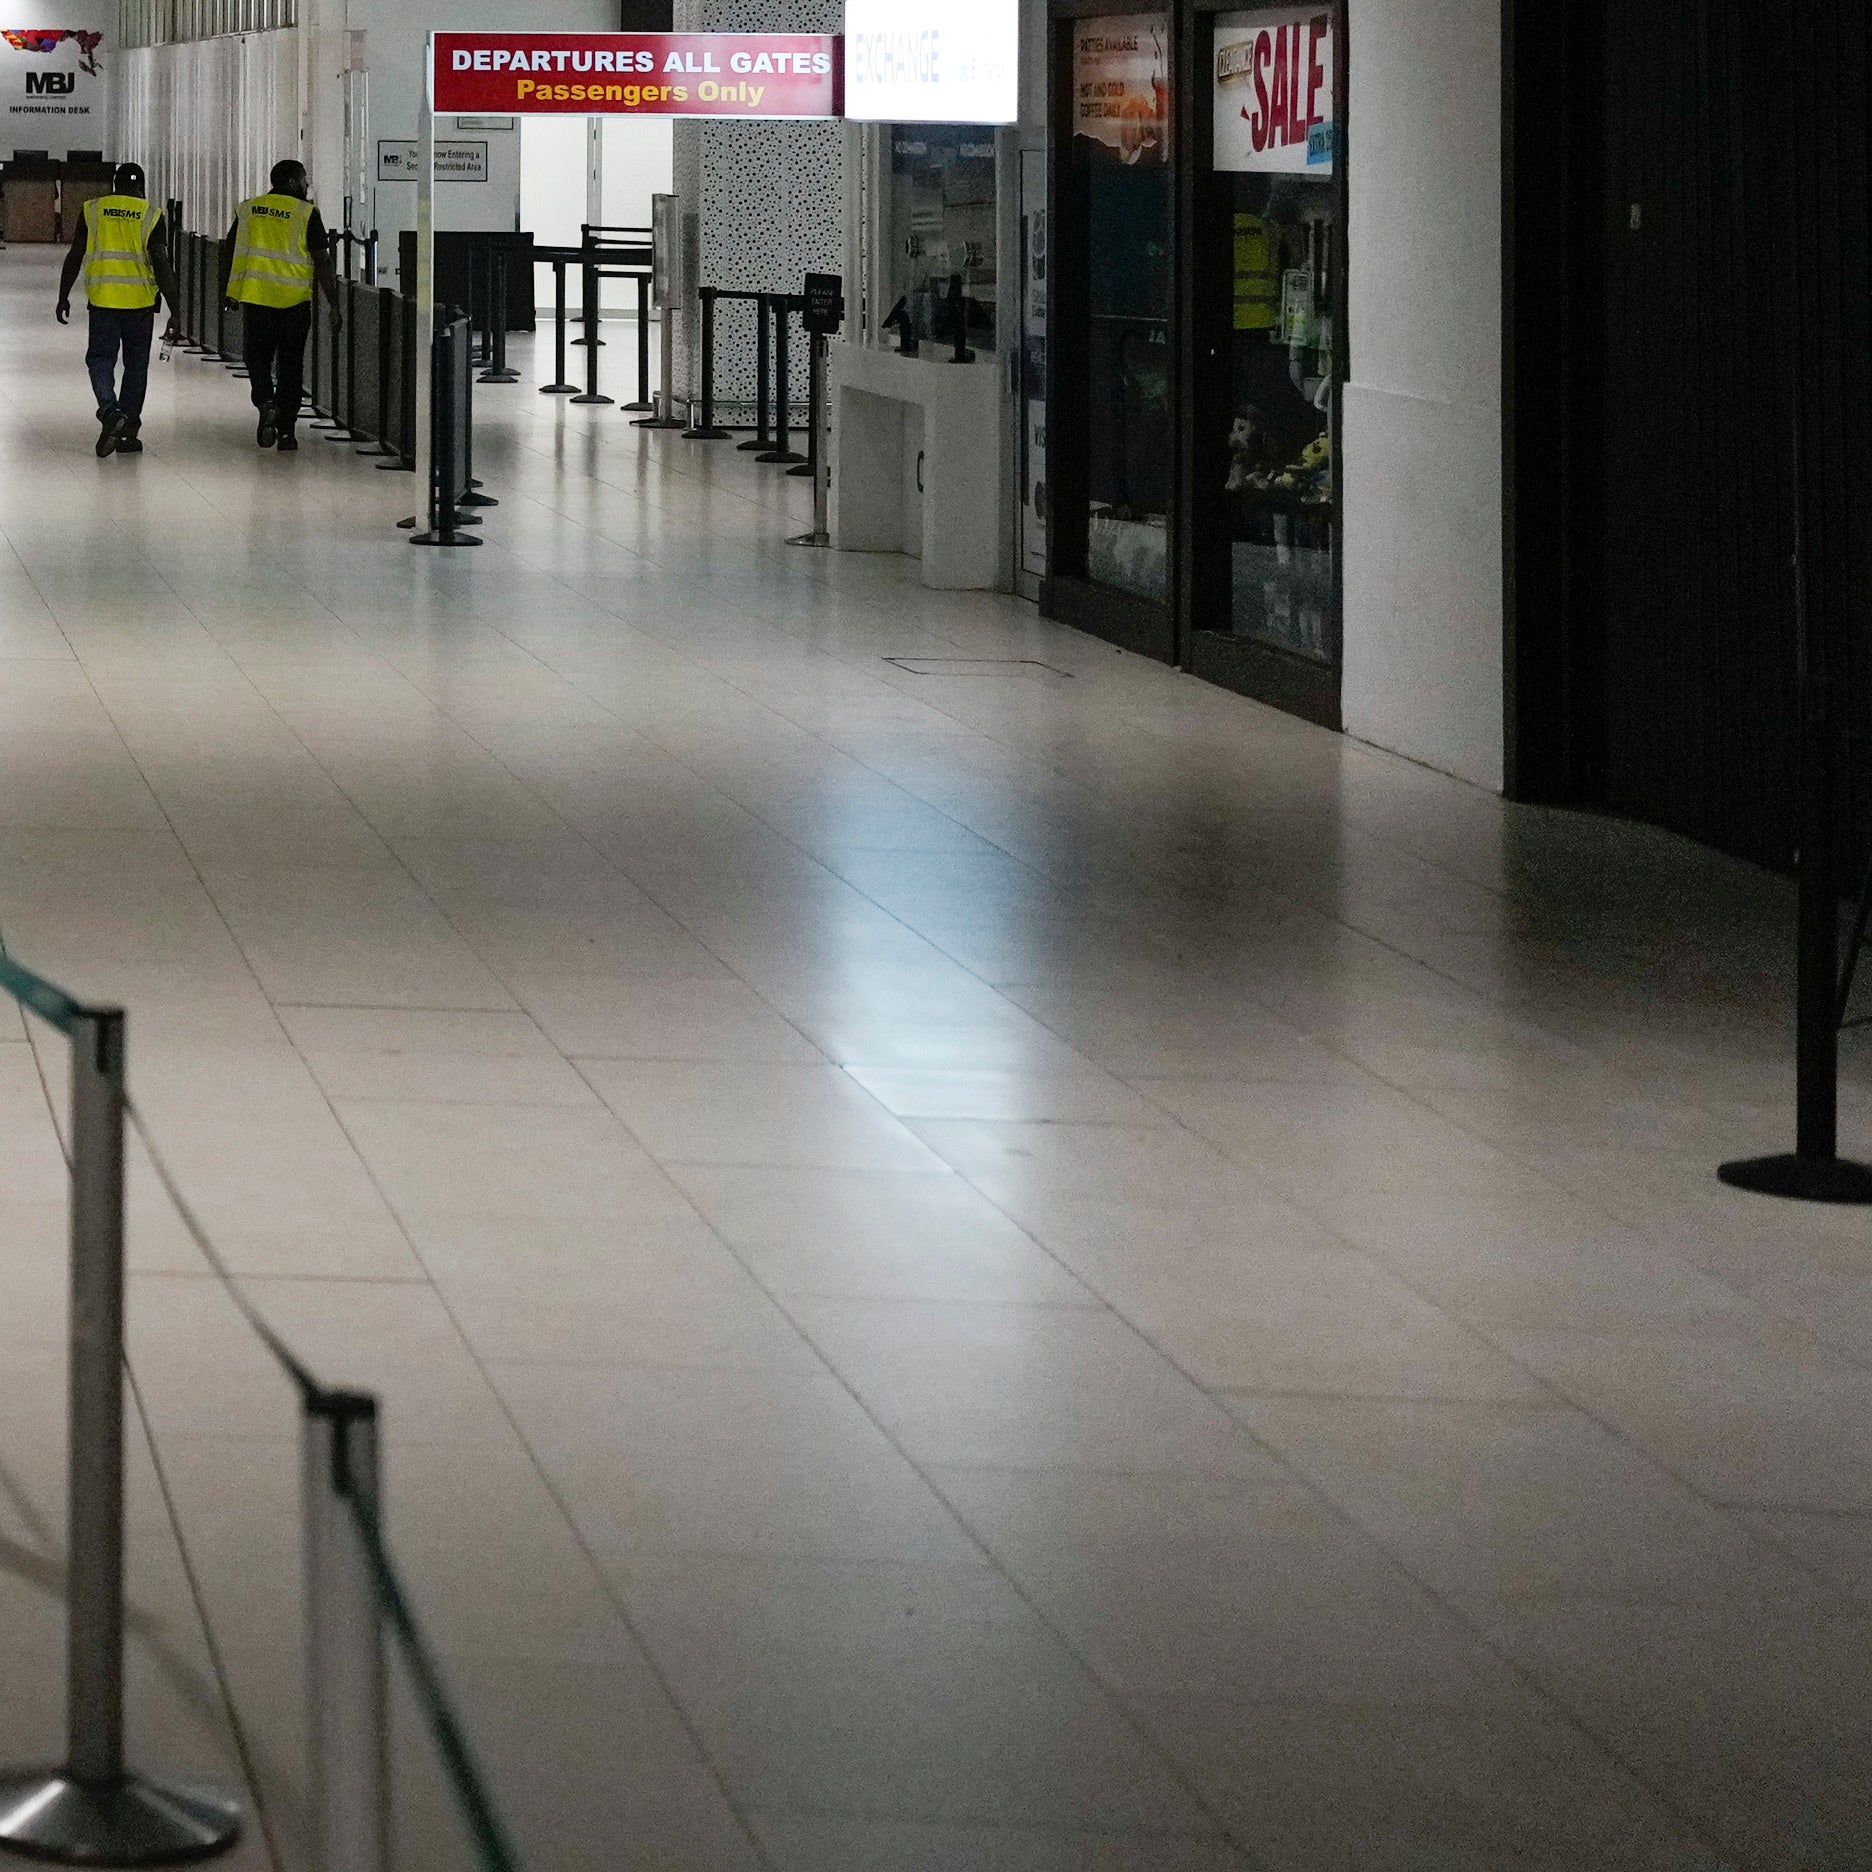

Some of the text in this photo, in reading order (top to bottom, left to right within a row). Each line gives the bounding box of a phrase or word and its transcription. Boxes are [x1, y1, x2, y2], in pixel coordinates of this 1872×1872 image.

[452, 49, 831, 75] DEPARTURES ALL GATES
[856, 30, 940, 83] EXCHANGE
[25, 71, 75, 94] MBJ
[517, 79, 765, 107] Passengers Only
[1251, 14, 1328, 153] SALE
[9, 106, 90, 114] INFORMATION DESK
[408, 150, 418, 158] Yo
[447, 150, 474, 161] Entering
[434, 162, 482, 171] Restricted Area
[268, 208, 292, 219] SMS
